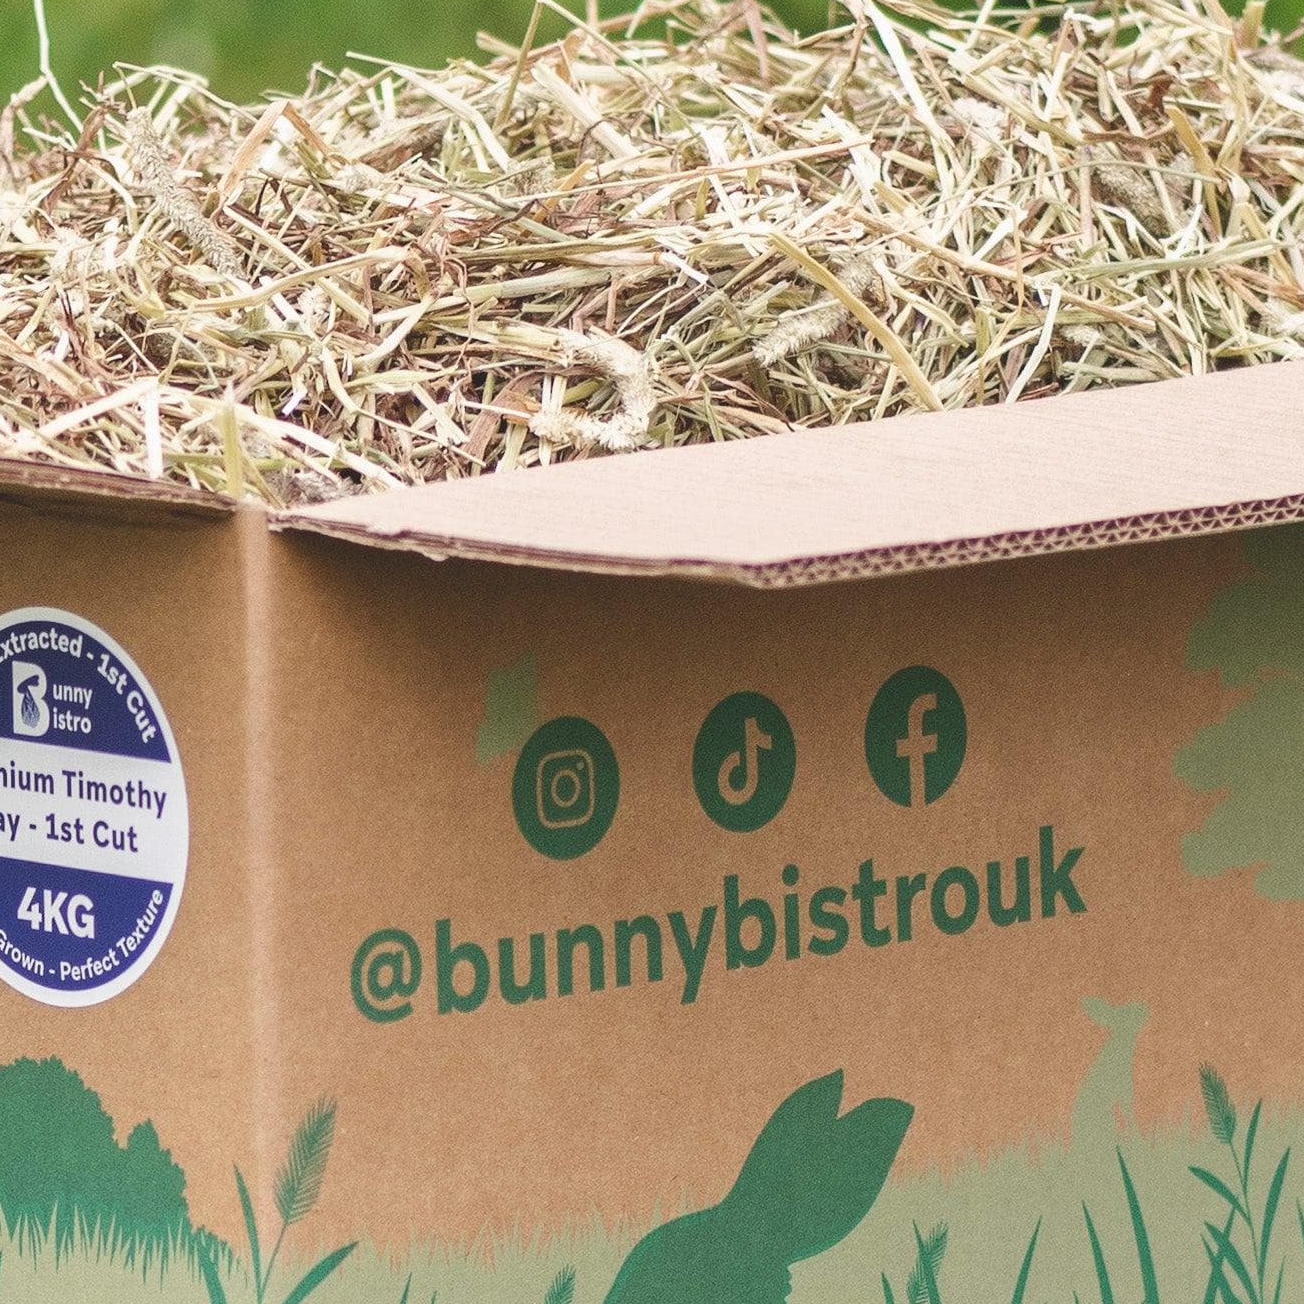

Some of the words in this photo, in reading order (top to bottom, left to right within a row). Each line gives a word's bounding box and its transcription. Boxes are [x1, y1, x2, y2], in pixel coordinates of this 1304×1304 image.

[97, 653, 128, 695] 1st
[126, 690, 157, 744] Cut
[62, 769, 167, 819] Timothy
[46, 812, 85, 845] 1st
[93, 820, 139, 853] Cut
[16, 886, 96, 940] 4KG
[59, 948, 121, 982] Perfect
[115, 888, 164, 959] Texture
[349, 825, 1088, 1024] @bunnybistrouk
